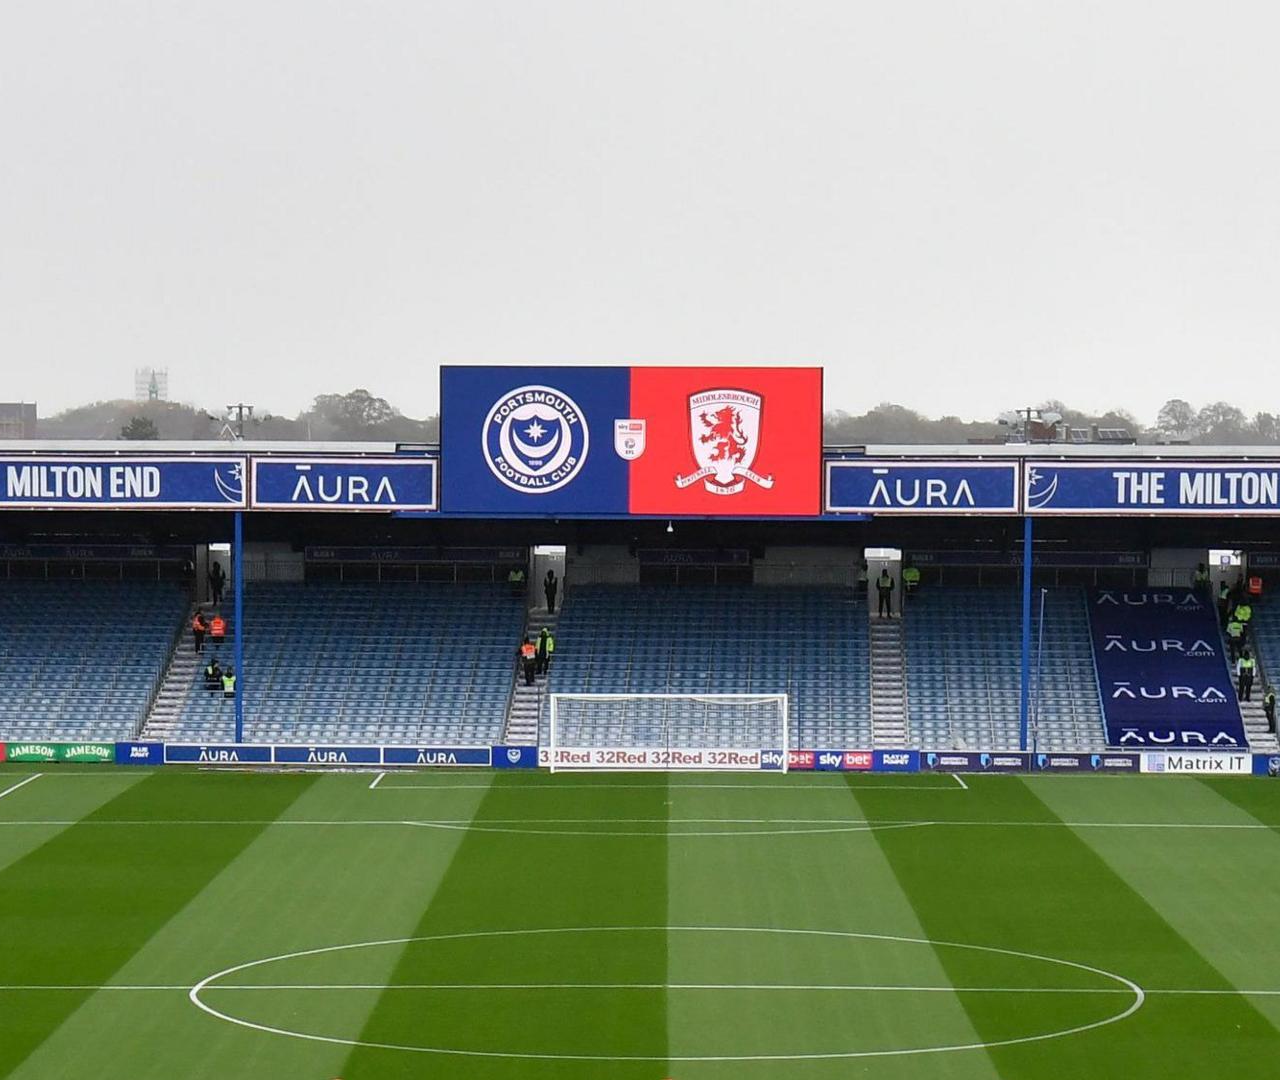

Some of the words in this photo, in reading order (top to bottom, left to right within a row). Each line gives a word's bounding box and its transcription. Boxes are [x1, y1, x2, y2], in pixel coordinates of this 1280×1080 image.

[692, 393, 759, 406] MIDDLESBROUGH
[494, 392, 578, 424] PORTSMOUTH
[495, 456, 550, 486] FOOTBALL
[551, 457, 577, 481] CLUB
[7, 466, 102, 497] MILTON
[110, 467, 160, 498] END
[1113, 472, 1164, 504] THE
[1180, 472, 1278, 505] MILTON
[9, 745, 55, 758] JAMESON
[65, 745, 111, 758] JAMESON
[596, 751, 647, 763] 32Red
[651, 751, 702, 764] 32Red
[708, 751, 758, 764] 32Red
[762, 752, 783, 768] sky
[789, 752, 812, 764] bet
[820, 753, 843, 768] sky
[846, 752, 868, 765] bet
[1168, 756, 1223, 770] Matrix
[1230, 757, 1245, 770] IT
